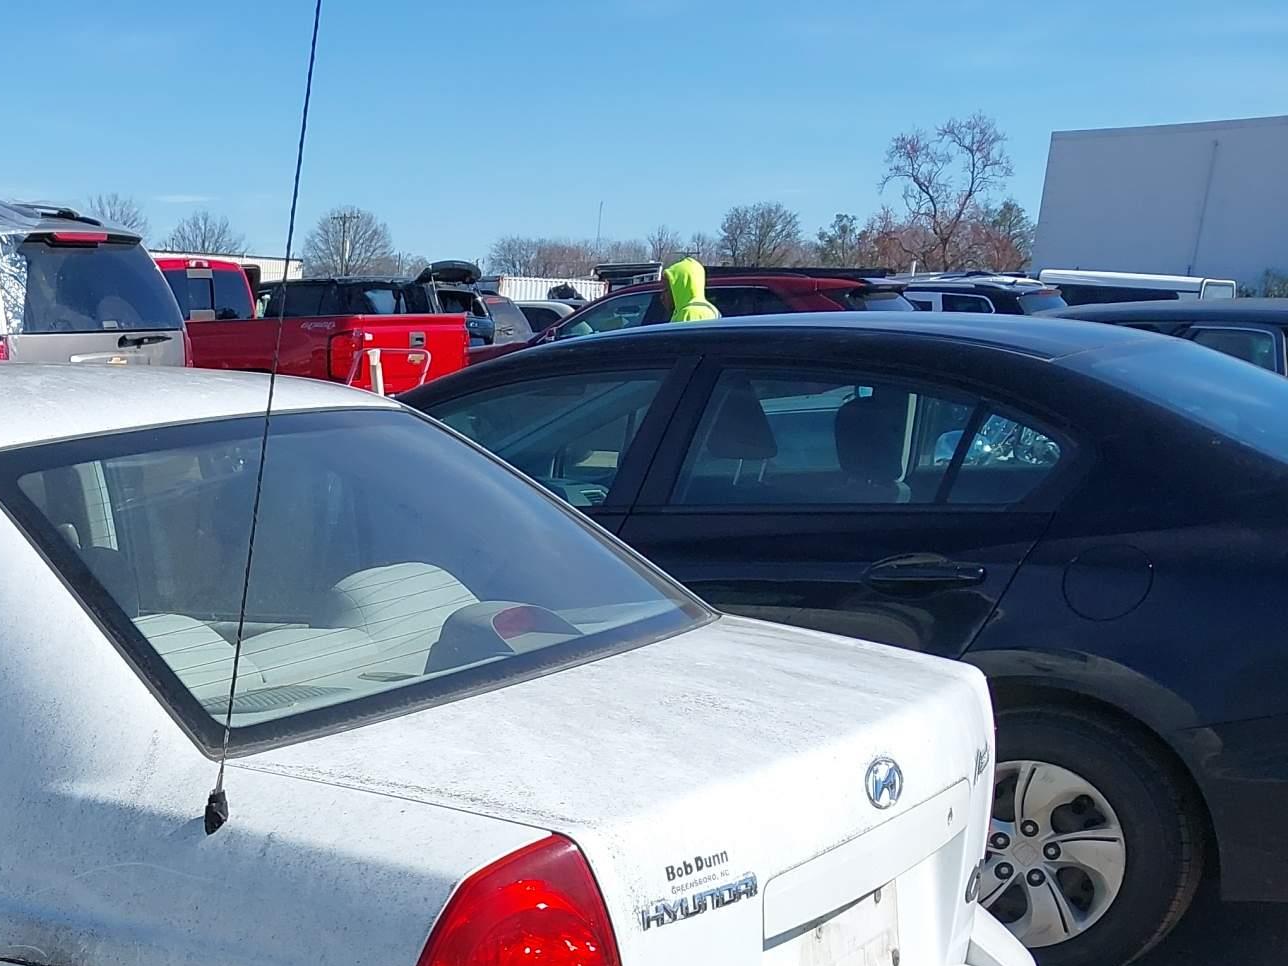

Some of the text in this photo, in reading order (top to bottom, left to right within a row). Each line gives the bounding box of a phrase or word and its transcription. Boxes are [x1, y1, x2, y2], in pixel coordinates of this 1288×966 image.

[665, 850, 729, 882] Bob Dunn
[641, 871, 758, 931] HYUNDAI
